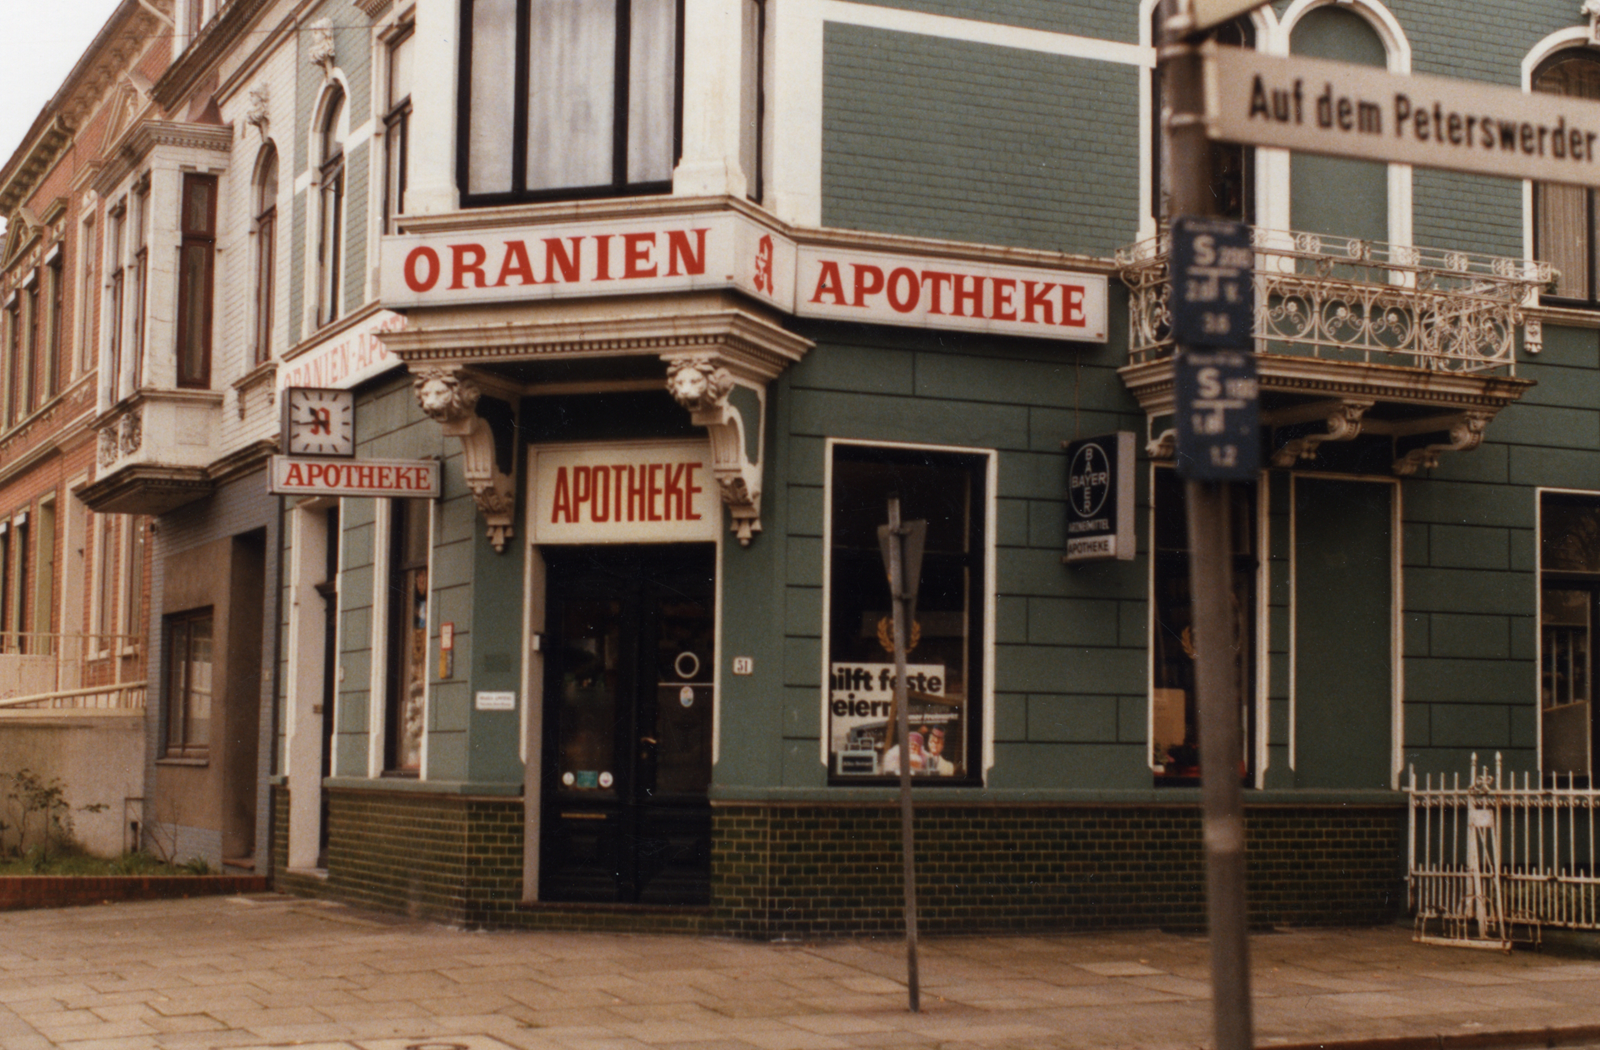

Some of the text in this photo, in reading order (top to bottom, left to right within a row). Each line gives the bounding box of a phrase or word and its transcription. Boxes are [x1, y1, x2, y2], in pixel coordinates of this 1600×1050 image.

[1249, 74, 1598, 163] Auf dem Peterswerder
[404, 228, 712, 293] ORANIEN
[808, 260, 1087, 328] APOTHEKE
[283, 463, 431, 490] APOTHEKE
[551, 463, 703, 524] APOTHEKE
[1071, 471, 1107, 489] BAYER
[1068, 540, 1109, 554] APOTHEKE
[738, 659, 749, 672] 51
